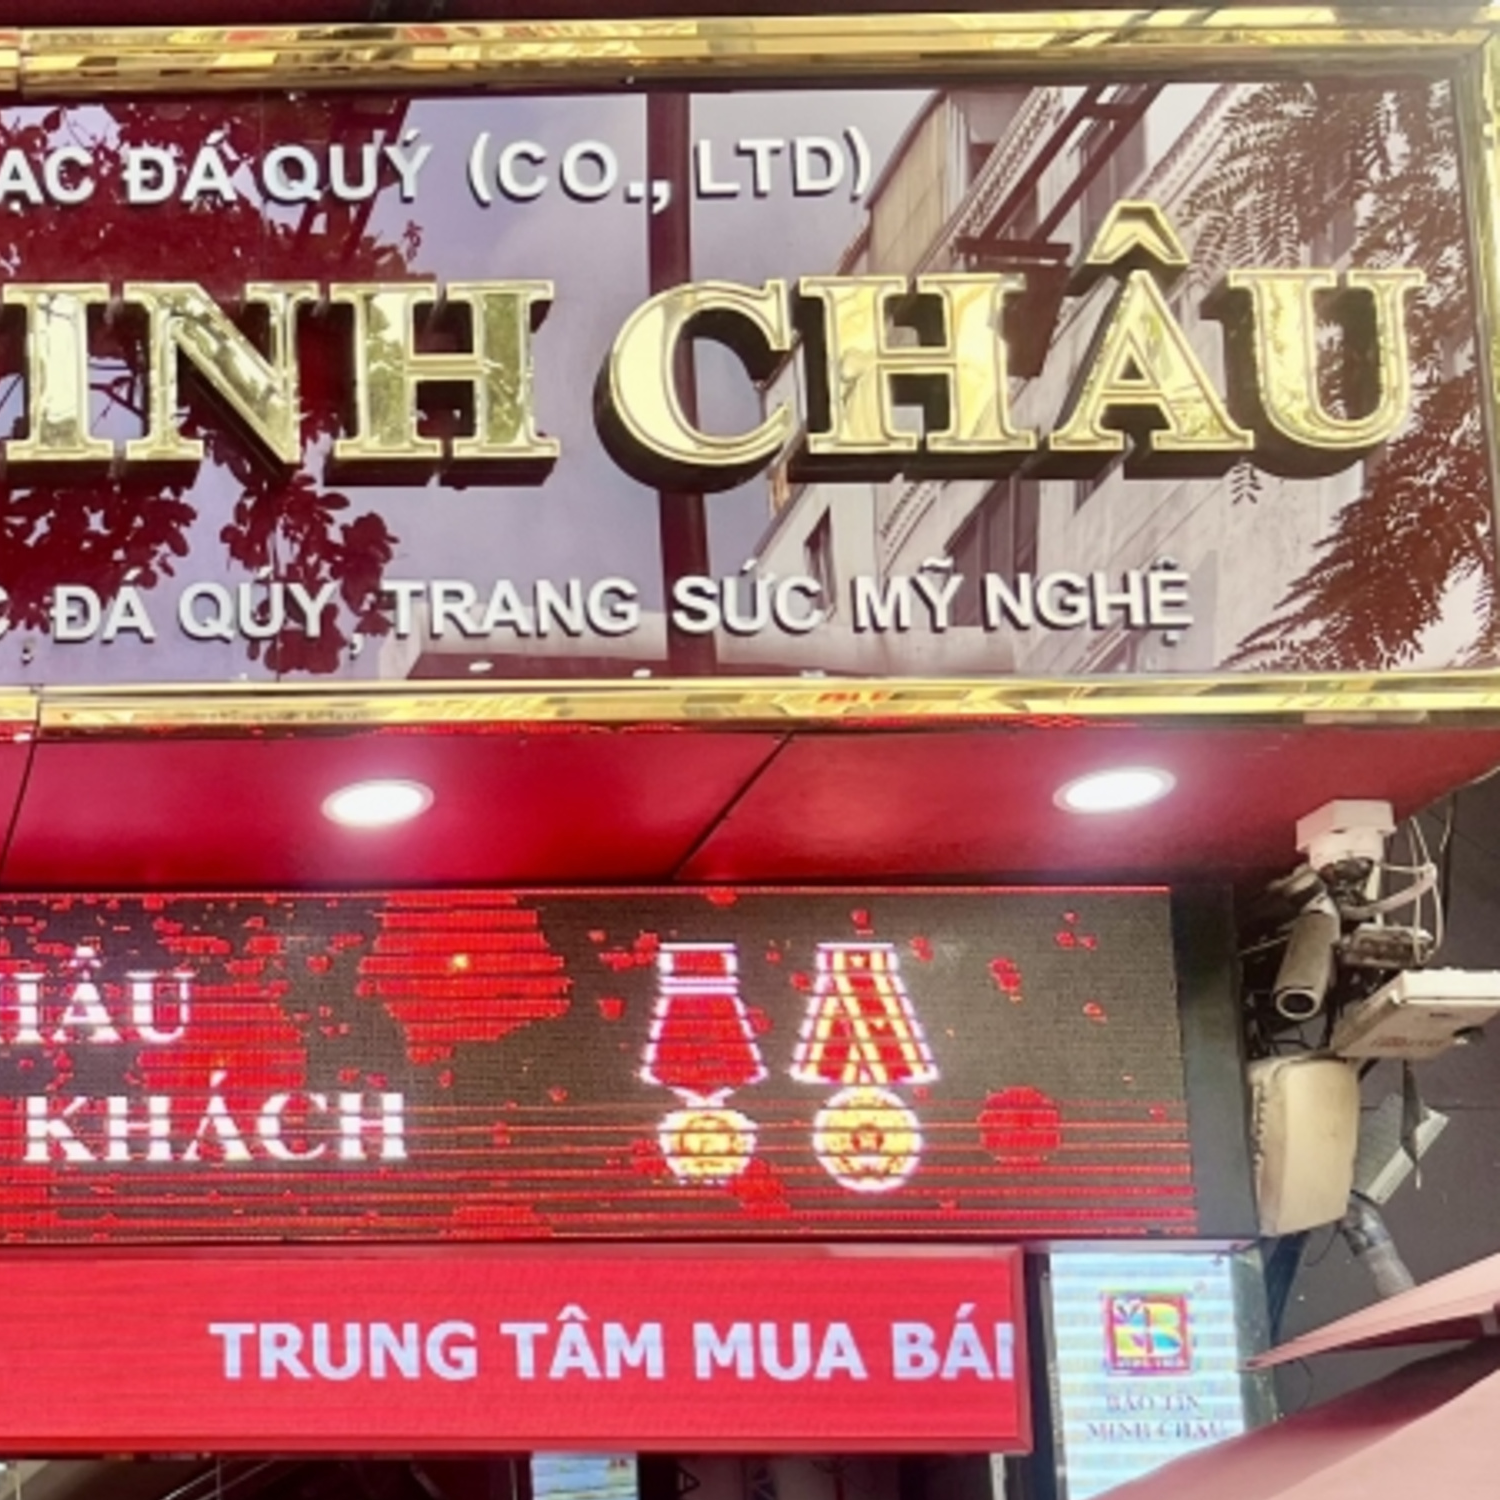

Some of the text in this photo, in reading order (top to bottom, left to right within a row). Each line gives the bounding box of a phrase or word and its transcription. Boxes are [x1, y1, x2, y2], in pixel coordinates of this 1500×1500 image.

[121, 131, 240, 204] ĐÁ
[261, 128, 433, 204] QUÝ
[467, 131, 672, 215] (CO.,
[695, 126, 872, 200] LTD)
[598, 201, 1426, 480] CHÂU
[50, 567, 156, 643] ĐÁ
[386, 577, 641, 640] TRANG
[671, 558, 823, 635] SỨC
[853, 556, 964, 633] MỸ
[982, 556, 1194, 646] NGHỆ
[23, 1069, 409, 1165] KHÁCH
[208, 1320, 479, 1380] TRUNG
[497, 1304, 665, 1380] TÂM
[691, 1322, 868, 1381] MUA
